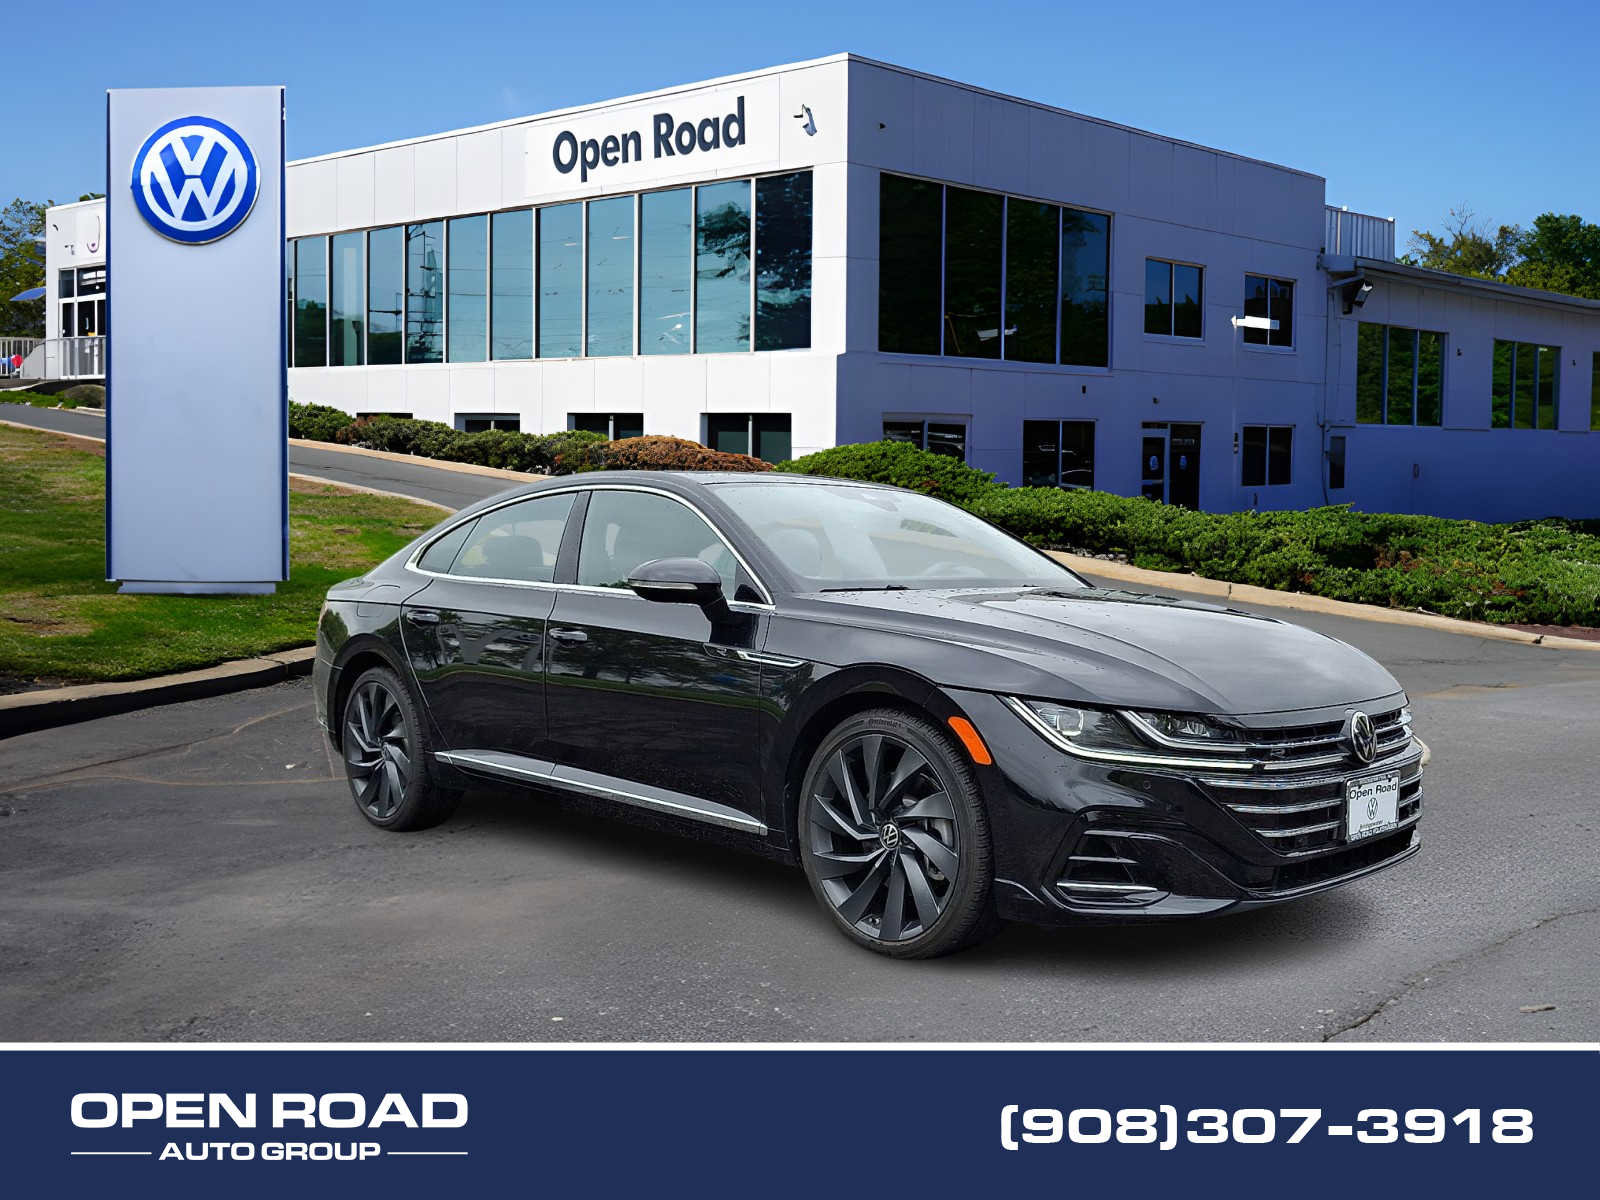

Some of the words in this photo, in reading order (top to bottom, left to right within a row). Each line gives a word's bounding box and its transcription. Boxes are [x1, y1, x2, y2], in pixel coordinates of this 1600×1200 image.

[553, 130, 641, 182] Open
[653, 97, 746, 158] Road
[1350, 789, 1372, 800] Open
[1376, 783, 1397, 794] Road
